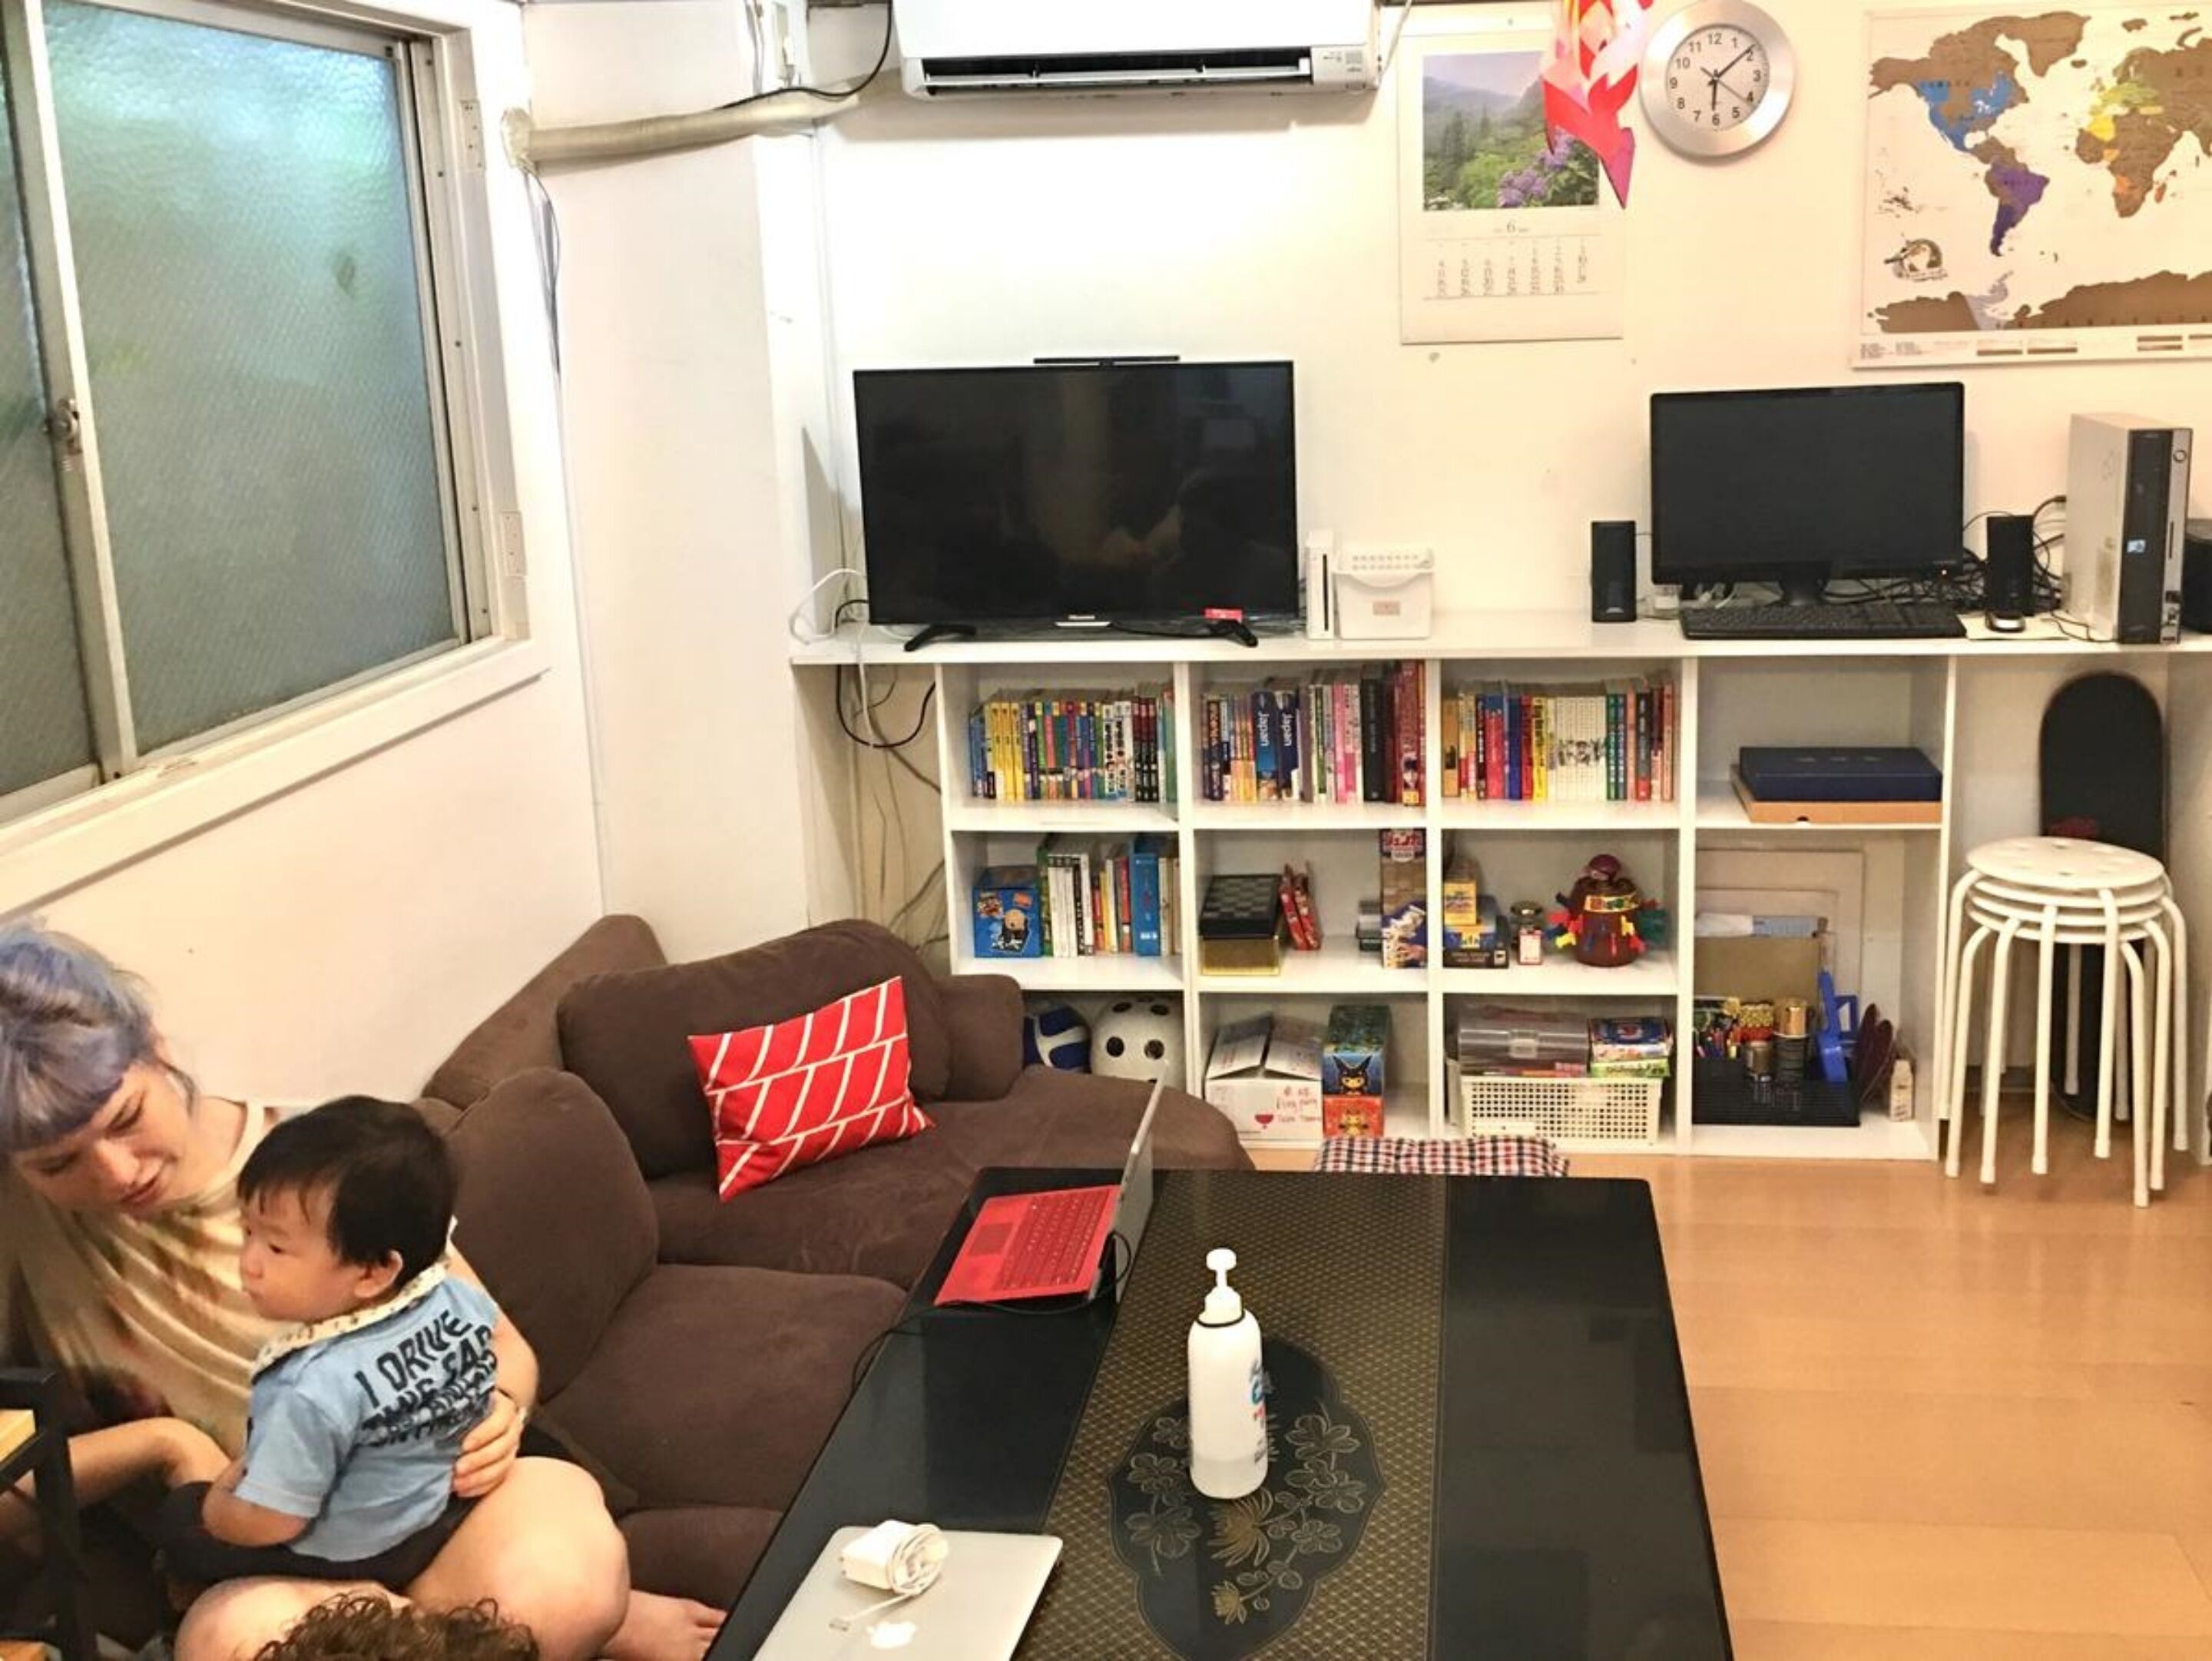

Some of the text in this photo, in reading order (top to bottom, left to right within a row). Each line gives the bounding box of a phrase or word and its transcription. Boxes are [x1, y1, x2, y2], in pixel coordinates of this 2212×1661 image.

[1708, 33, 1722, 45] 12
[1732, 37, 1737, 48] 1
[1689, 41, 1701, 53] 11
[1747, 49, 1753, 61] 2
[1676, 58, 1690, 69] 10
[1753, 70, 1761, 82] 3
[1669, 78, 1677, 89] 9
[1747, 91, 1754, 103] 4
[1677, 98, 1685, 109] 8
[1693, 111, 1701, 121] 7
[1732, 107, 1740, 118] 5
[1712, 114, 1720, 126] 6
[1507, 220, 1516, 233] 6
[1257, 711, 1270, 746] Japan
[1280, 712, 1293, 746] Japan
[354, 1371, 380, 1409] I
[376, 1309, 473, 1391] DRIVE
